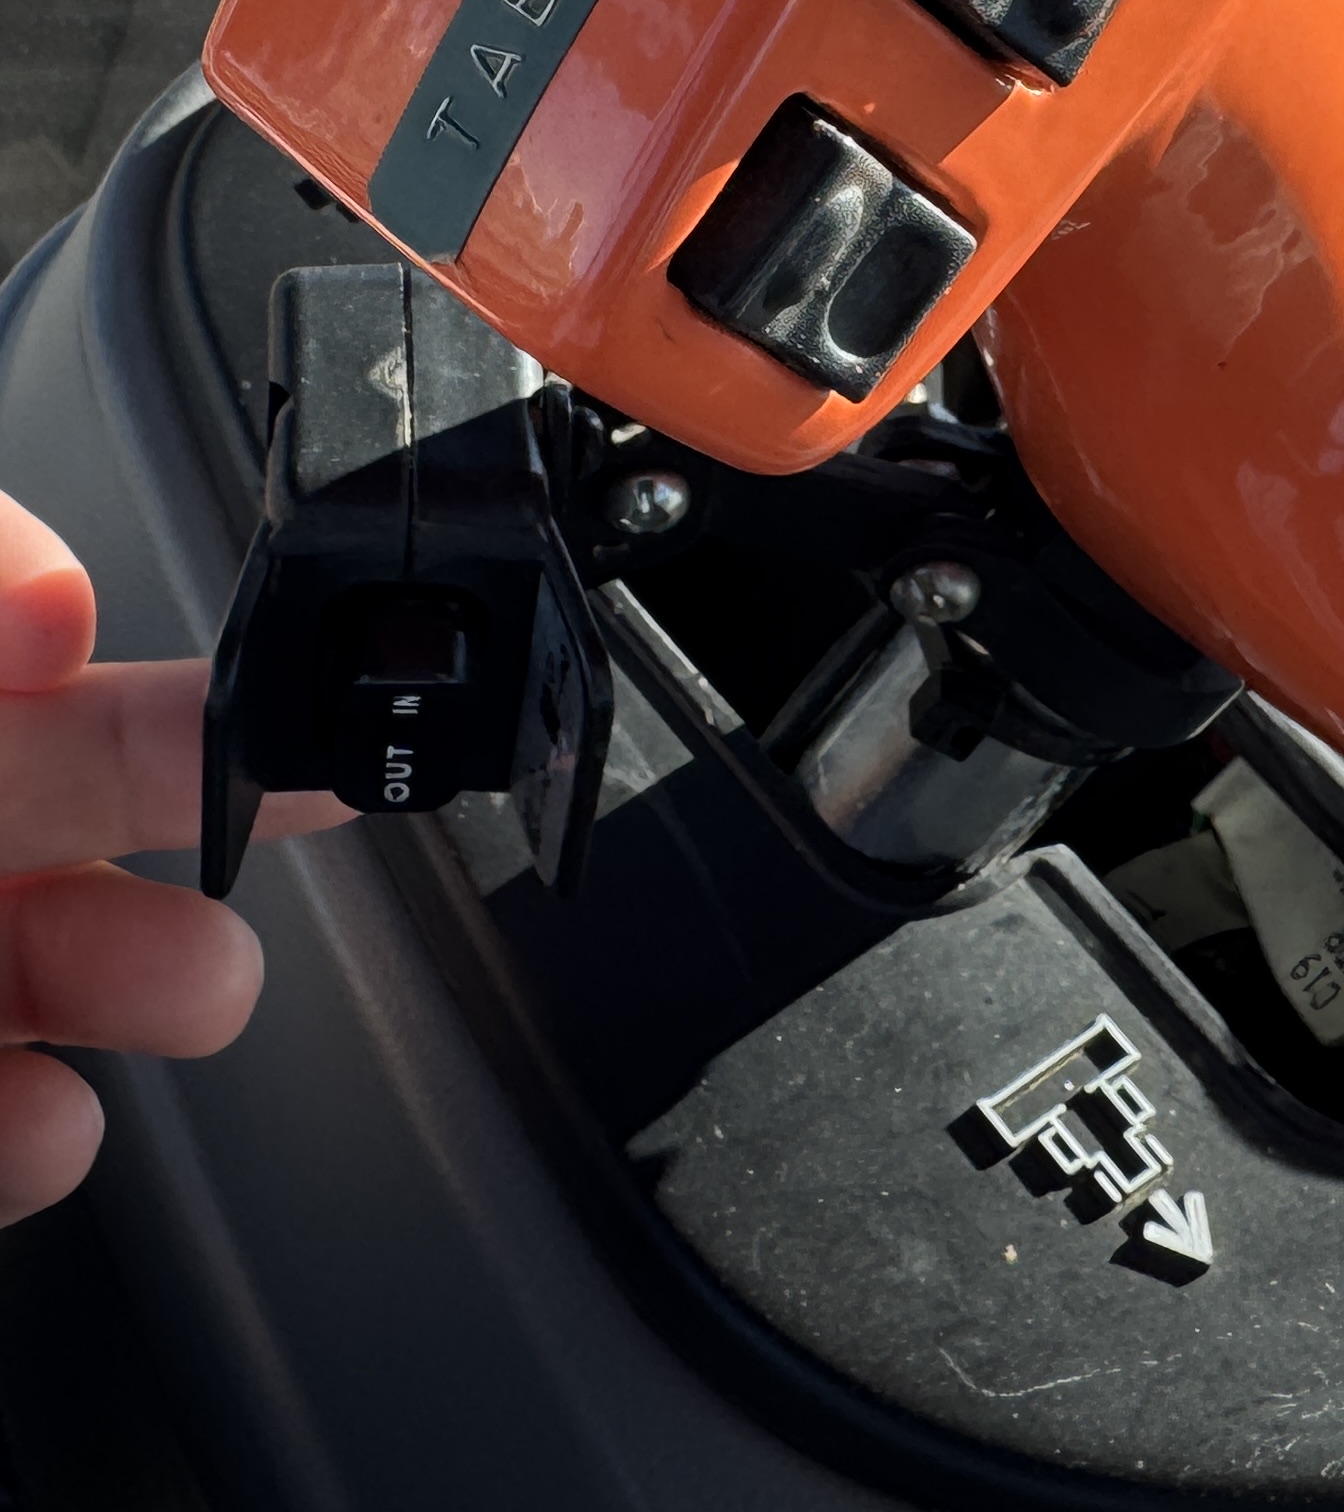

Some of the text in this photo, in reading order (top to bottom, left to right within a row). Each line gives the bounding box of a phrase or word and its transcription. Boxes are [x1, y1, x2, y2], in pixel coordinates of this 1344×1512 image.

[383, 694, 423, 804] OUT IN
[1290, 952, 1343, 1011] C19
